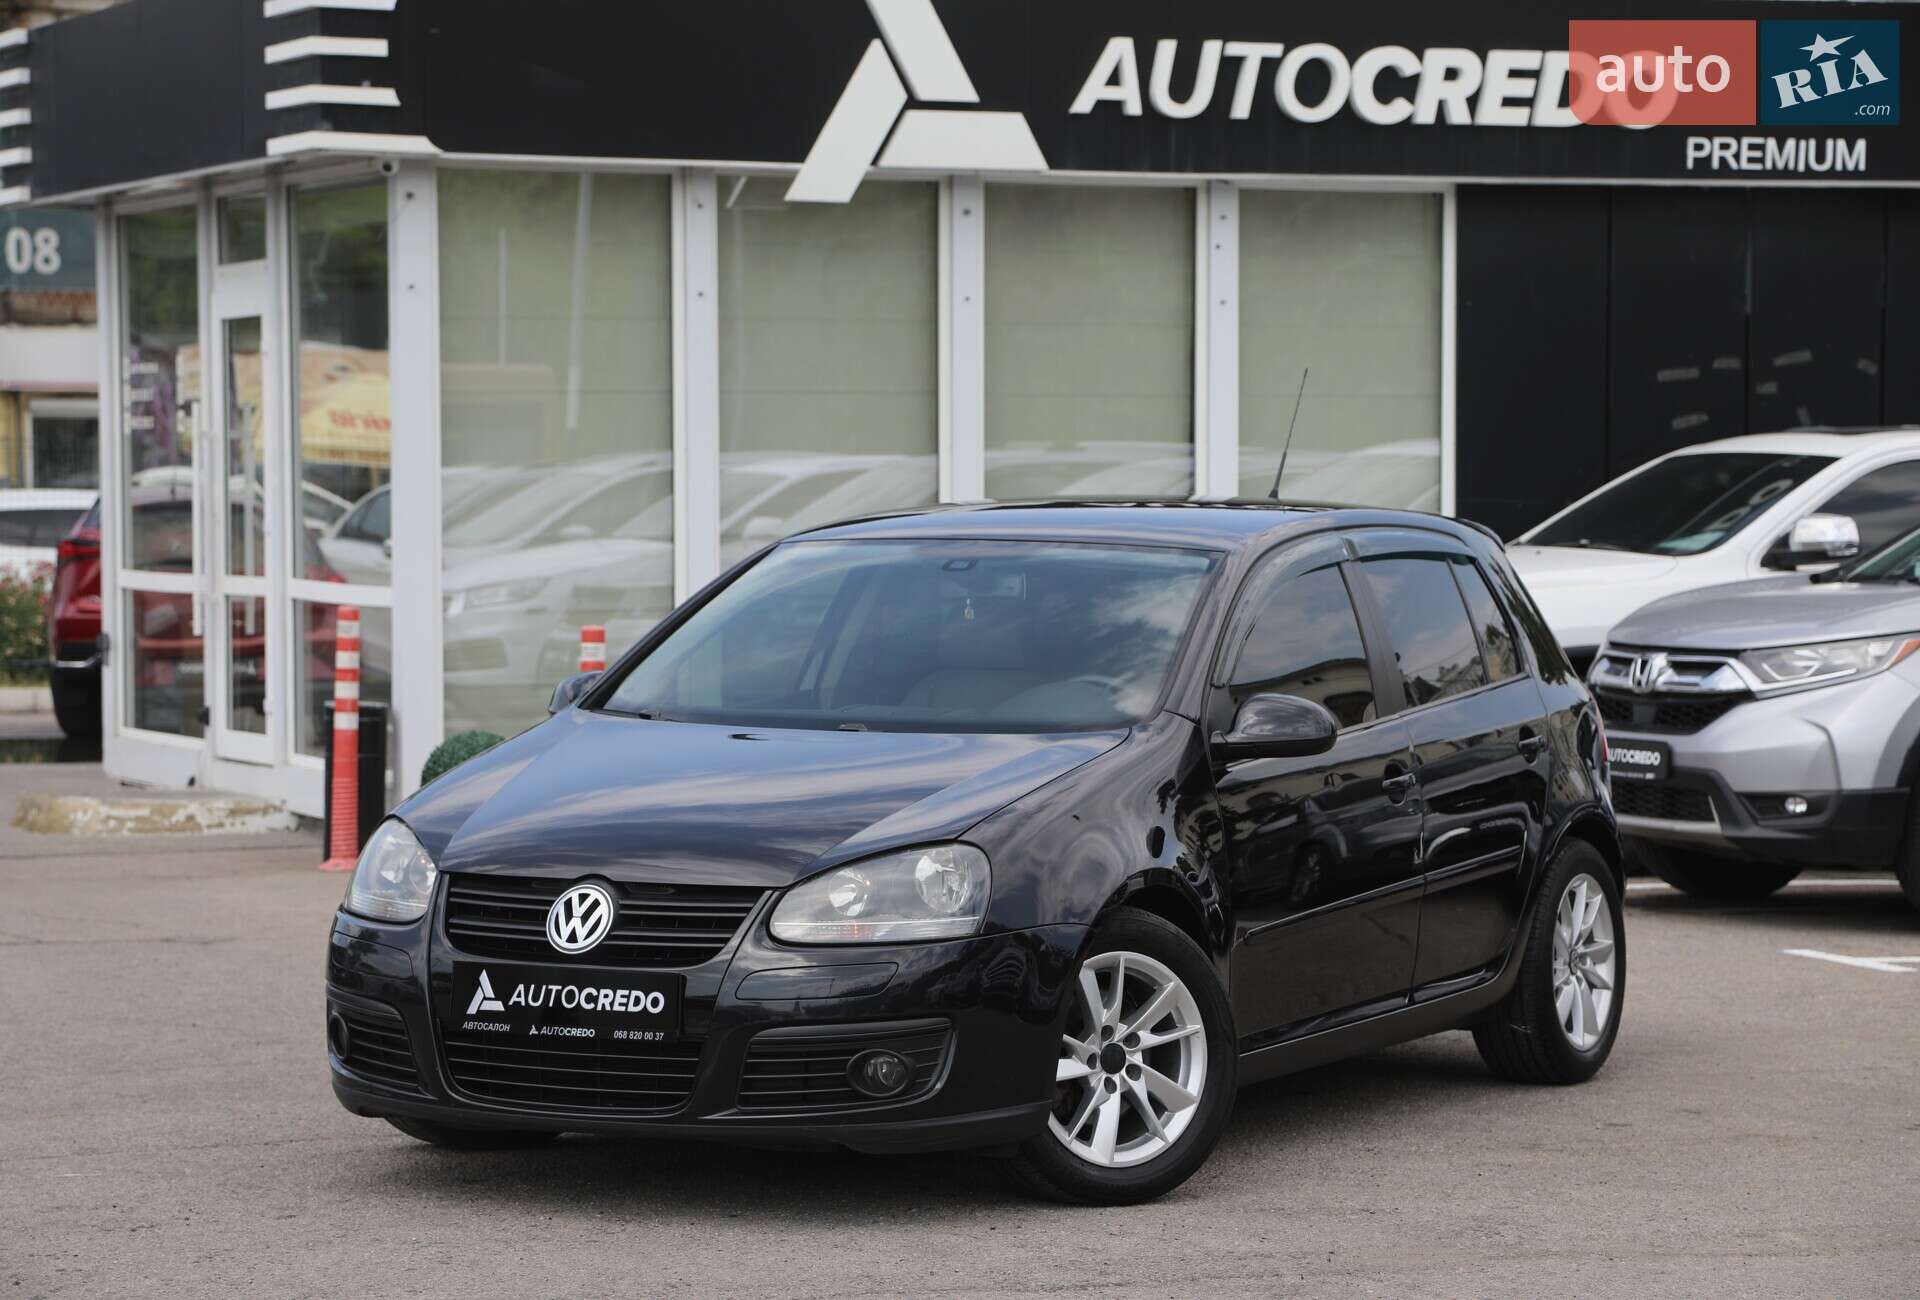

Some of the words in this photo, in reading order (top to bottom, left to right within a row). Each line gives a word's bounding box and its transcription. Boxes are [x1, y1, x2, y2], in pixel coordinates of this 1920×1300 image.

[1068, 36, 1679, 130] AUTOCREDO
[1686, 137, 1867, 173] PREMIUM
[5, 227, 62, 274] 08
[1608, 748, 1661, 766] UTOCREDO
[508, 983, 665, 1014] AUTOCREDO
[462, 1021, 511, 1032] АВТОСАЛОН
[540, 1026, 595, 1037] AUTOCREDO
[613, 1030, 628, 1040] 068
[628, 1031, 643, 1040] 820
[644, 1032, 654, 1041] 00
[655, 1032, 664, 1041] 37
